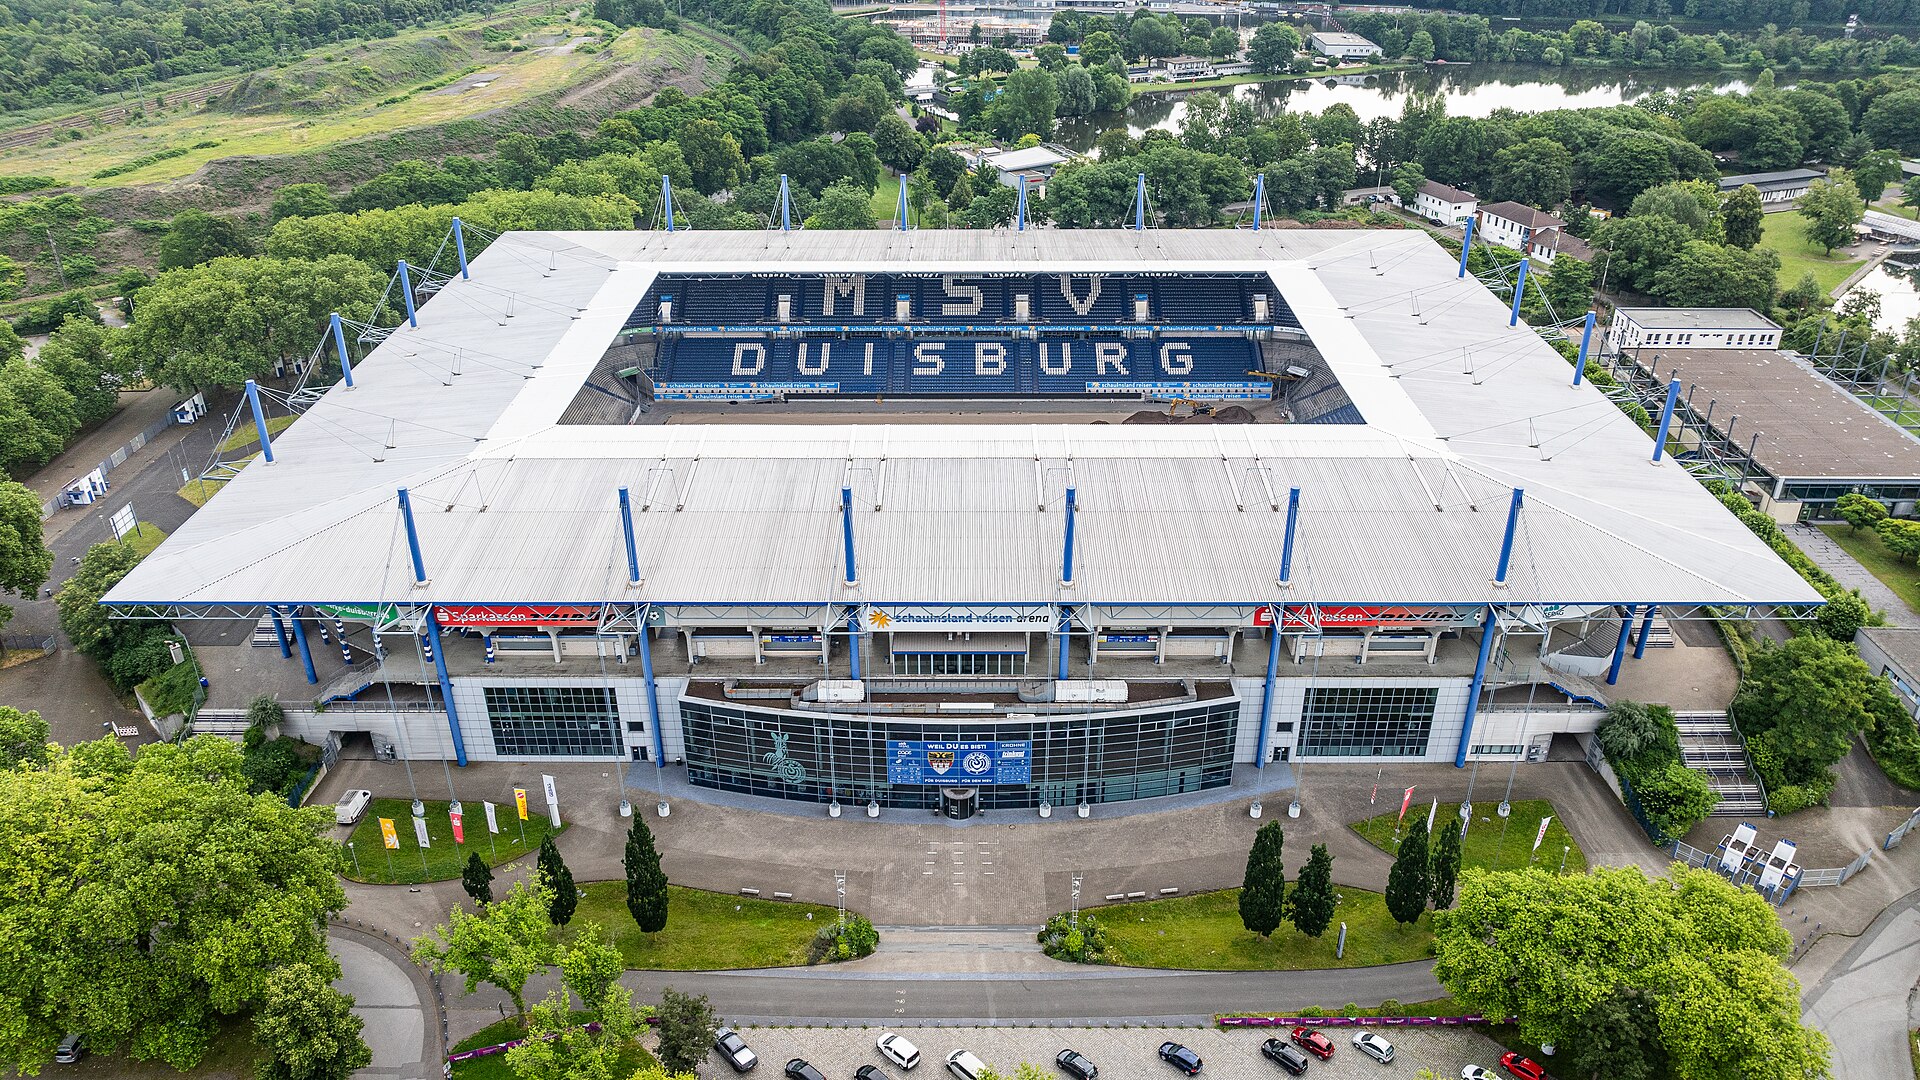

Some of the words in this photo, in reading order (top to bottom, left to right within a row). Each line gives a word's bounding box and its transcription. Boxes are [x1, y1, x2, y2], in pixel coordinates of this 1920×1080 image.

[731, 342, 1194, 376] DUISBURG
[452, 611, 527, 624] Sparkassen
[895, 613, 973, 623] schauinsland
[976, 613, 1012, 623] reisen
[1016, 615, 1049, 623] arena
